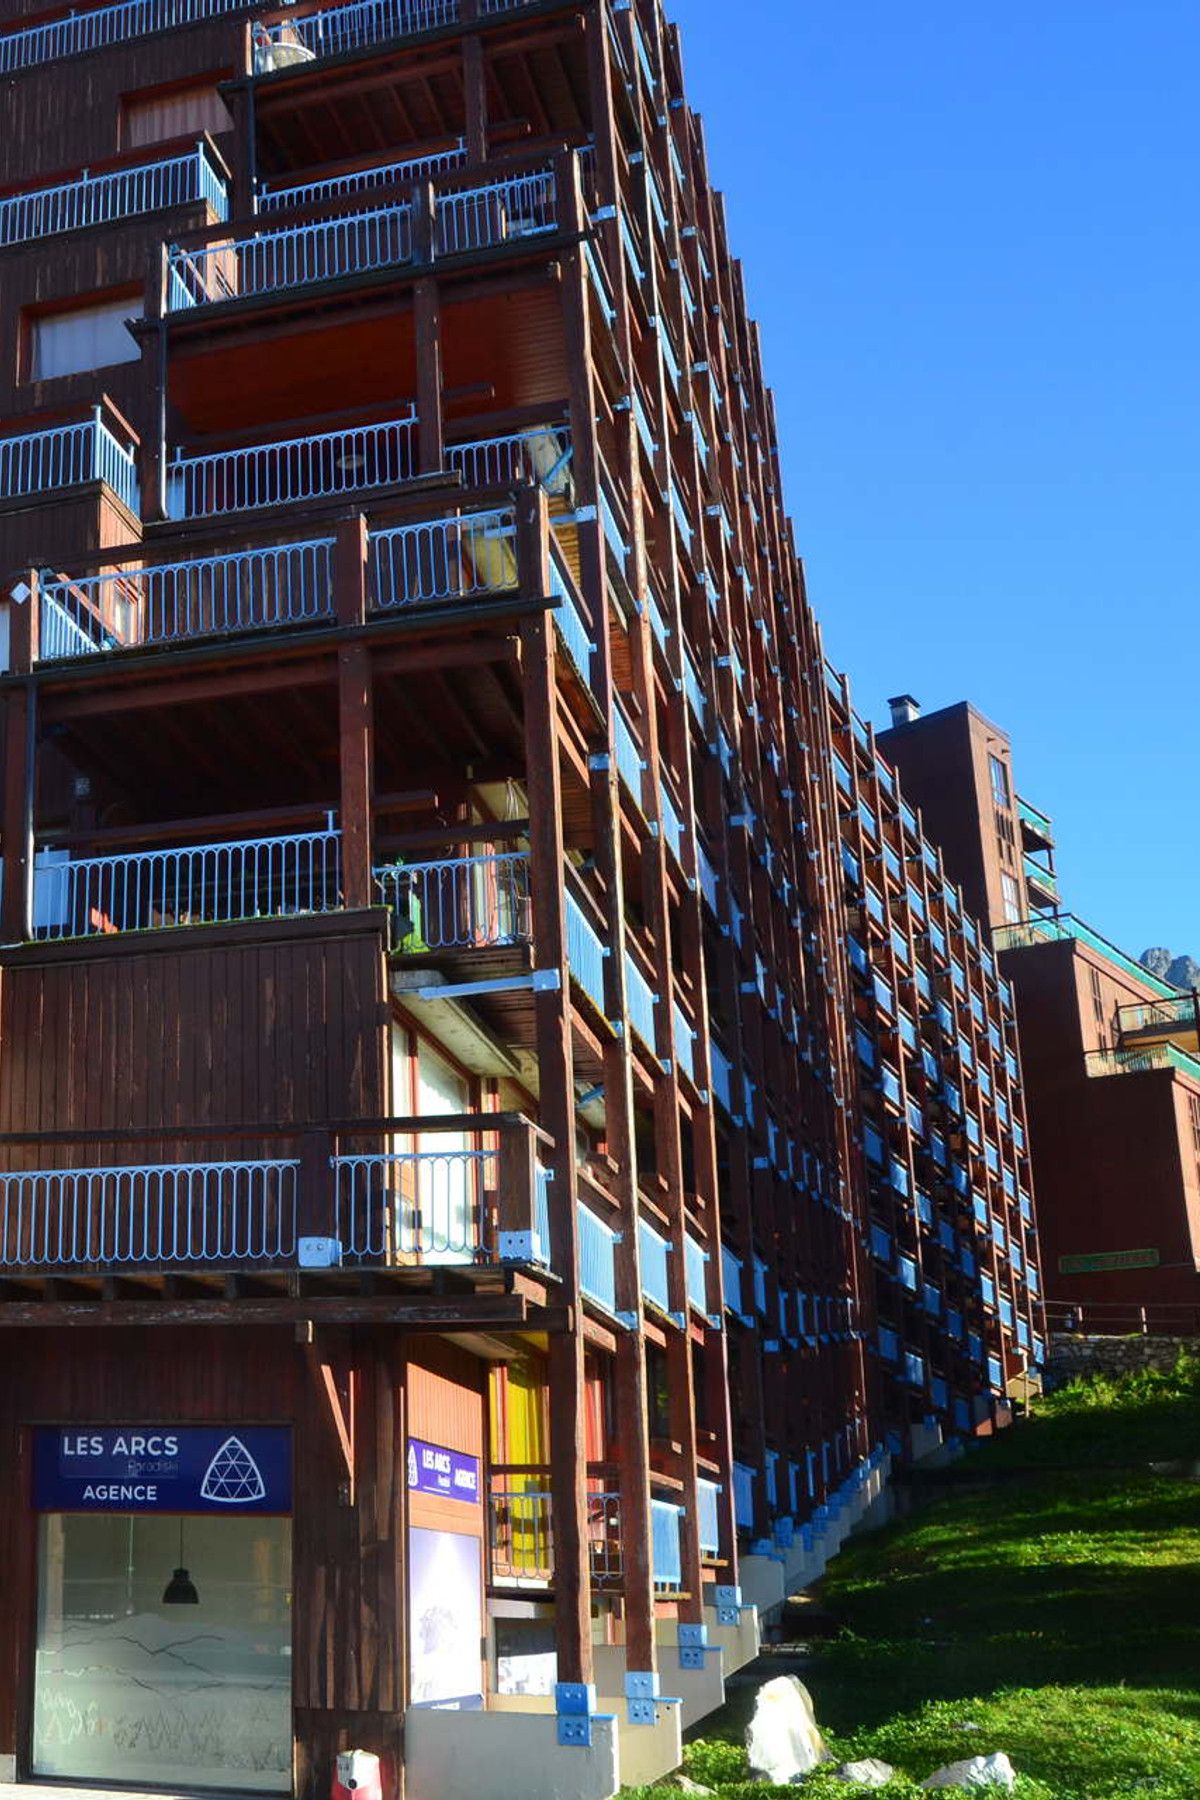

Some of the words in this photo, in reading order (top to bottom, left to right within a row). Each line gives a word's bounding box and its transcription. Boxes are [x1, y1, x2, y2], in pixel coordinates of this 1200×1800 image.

[63, 1436, 104, 1456] LES
[112, 1436, 179, 1457] ARCS
[82, 1485, 158, 1501] AGENCE
